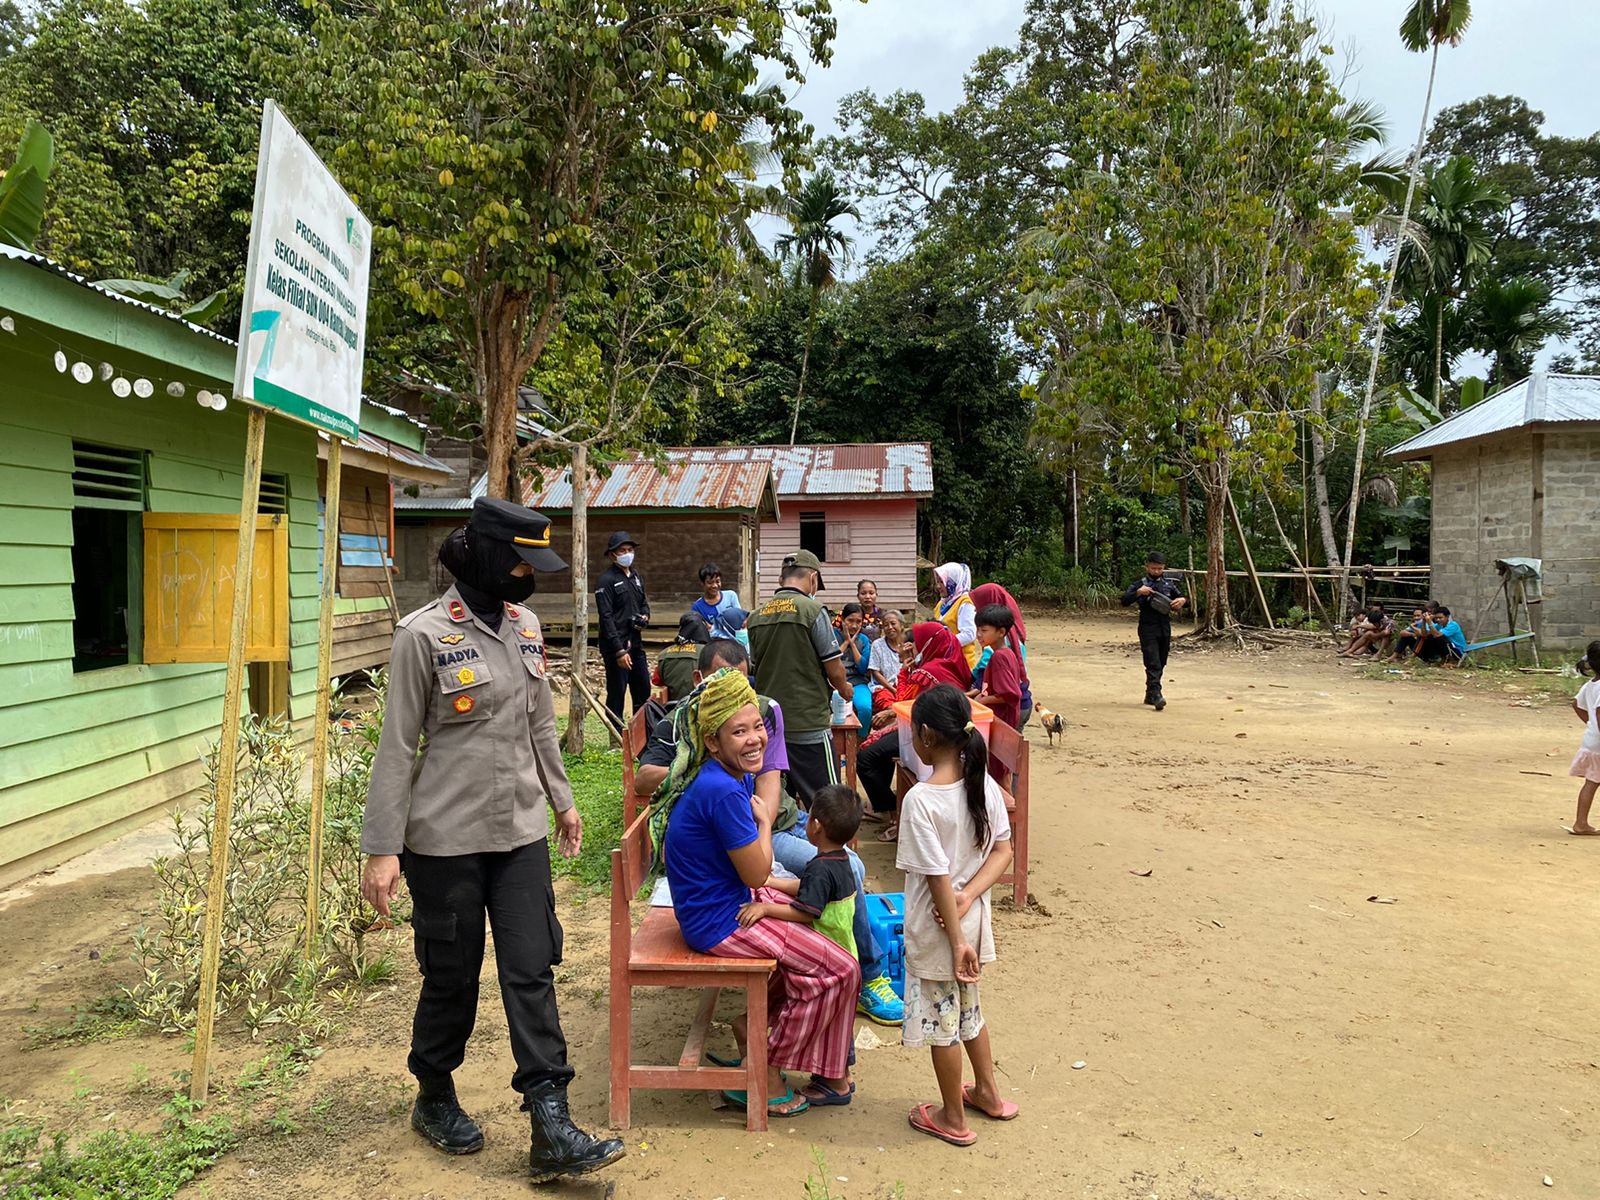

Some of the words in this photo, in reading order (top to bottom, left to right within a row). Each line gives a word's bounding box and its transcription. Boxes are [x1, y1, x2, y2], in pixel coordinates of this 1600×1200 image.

[274, 238, 310, 278] SEKOLAH
[310, 265, 336, 298] LITERASI
[335, 287, 357, 318] INDONESIA
[295, 218, 331, 261] PROGRAM
[331, 250, 350, 282] INISIASI
[266, 264, 287, 299] Kelas
[287, 277, 306, 311] Filial
[318, 299, 330, 326] 004
[437, 648, 479, 666] NADYA
